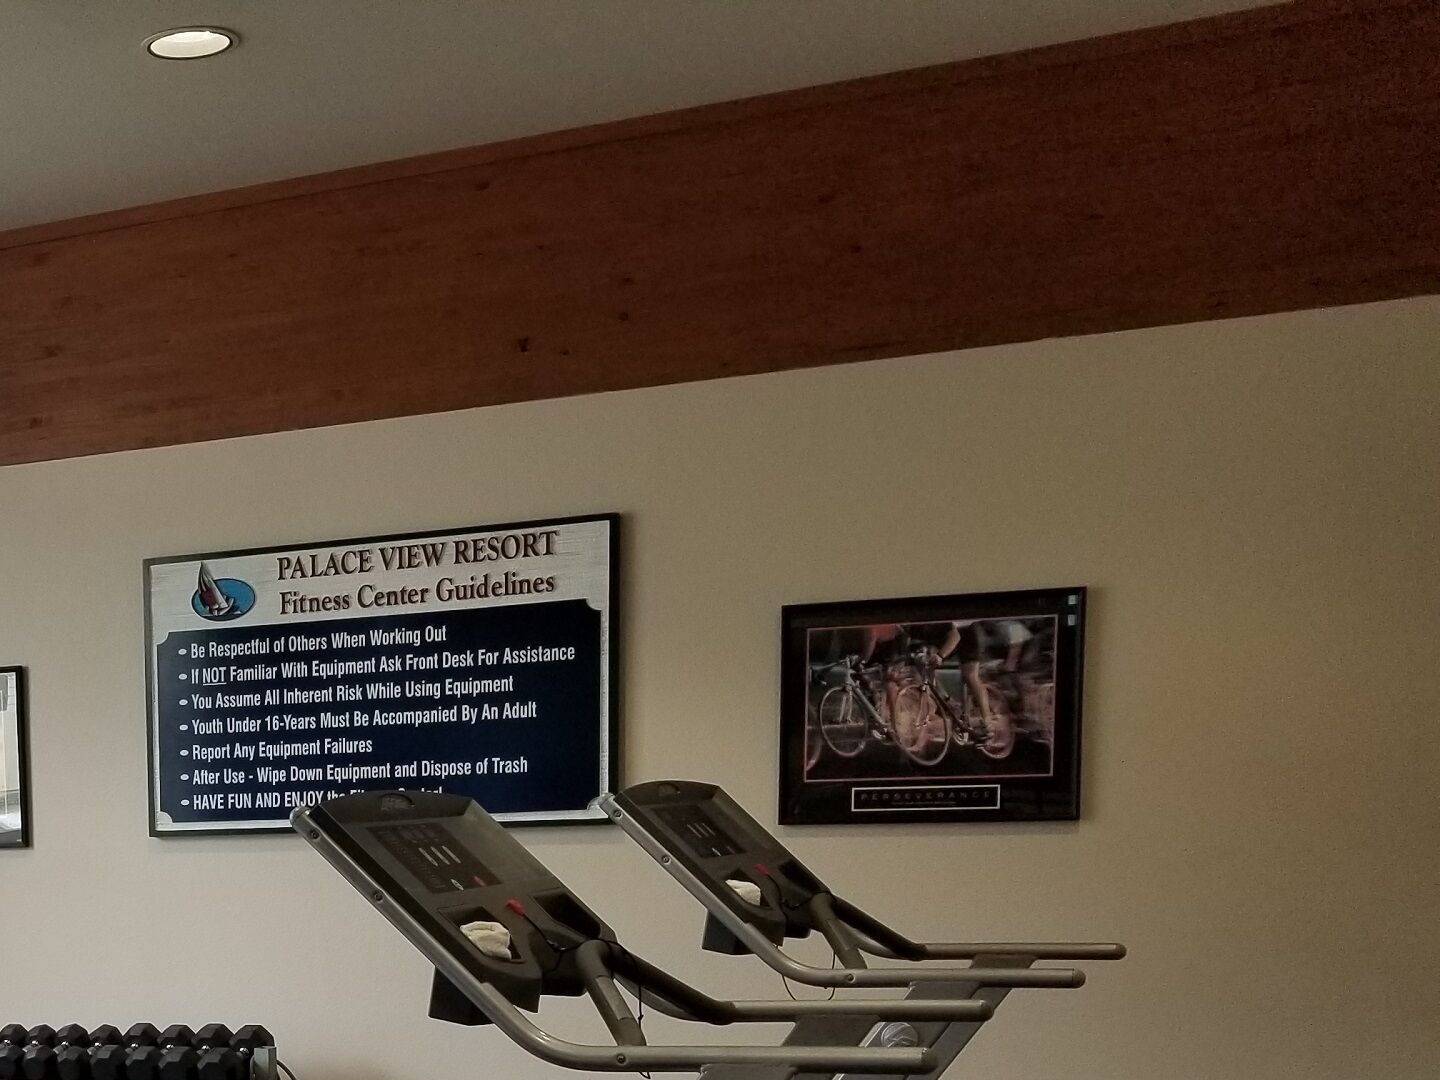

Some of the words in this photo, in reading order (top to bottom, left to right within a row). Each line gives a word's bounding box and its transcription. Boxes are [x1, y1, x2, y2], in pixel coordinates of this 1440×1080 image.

[277, 549, 373, 580] PALACE
[379, 542, 446, 571] VIEW
[453, 530, 558, 565] RESORT
[279, 590, 350, 615] Fitness
[357, 584, 428, 608] Center
[436, 571, 556, 602] Guidelines
[191, 643, 205, 658] Be
[209, 638, 269, 659] Respectful
[274, 637, 284, 653] of
[288, 635, 327, 652] Others
[331, 632, 365, 648] When
[370, 628, 420, 646] Working
[425, 625, 447, 642] Out
[192, 668, 199, 684] If
[203, 667, 226, 684] NOT
[230, 664, 277, 682] Familiar
[281, 662, 308, 678] With
[312, 657, 376, 678] Equipment
[379, 655, 401, 672] Ask
[406, 653, 438, 670] Front
[443, 650, 474, 668] Desk
[478, 649, 499, 666] For
[503, 646, 575, 664] Assistance
[192, 694, 212, 710] You
[216, 692, 261, 708] Assume
[265, 690, 280, 705] All
[284, 688, 332, 704] Inherent
[337, 685, 362, 700] Risk
[366, 682, 401, 699] While
[406, 680, 441, 699] Using
[446, 676, 513, 698] Equipment
[192, 719, 223, 734] Youth
[227, 716, 261, 733] Under
[265, 714, 316, 731] 16-Years
[320, 712, 350, 728] Must
[354, 712, 369, 726] Be
[373, 705, 457, 727] Accompanied
[462, 705, 478, 724] By
[481, 703, 498, 720] An
[503, 702, 537, 719] Adult
[192, 743, 230, 762] Report
[234, 743, 255, 761] Any
[259, 740, 321, 759] Equipment
[325, 738, 372, 755] Failures
[193, 770, 220, 785] After
[224, 769, 245, 784] Use
[257, 767, 286, 786] Wipe
[290, 767, 322, 782] Down
[327, 763, 390, 783] Equipment
[395, 761, 416, 777] and
[422, 760, 471, 778] Dispose
[476, 758, 488, 774] of
[492, 756, 528, 773] Trash
[193, 794, 224, 810] HAVE
[228, 794, 251, 809] FUN
[256, 792, 280, 808] AND
[285, 791, 324, 807] ENJOY
